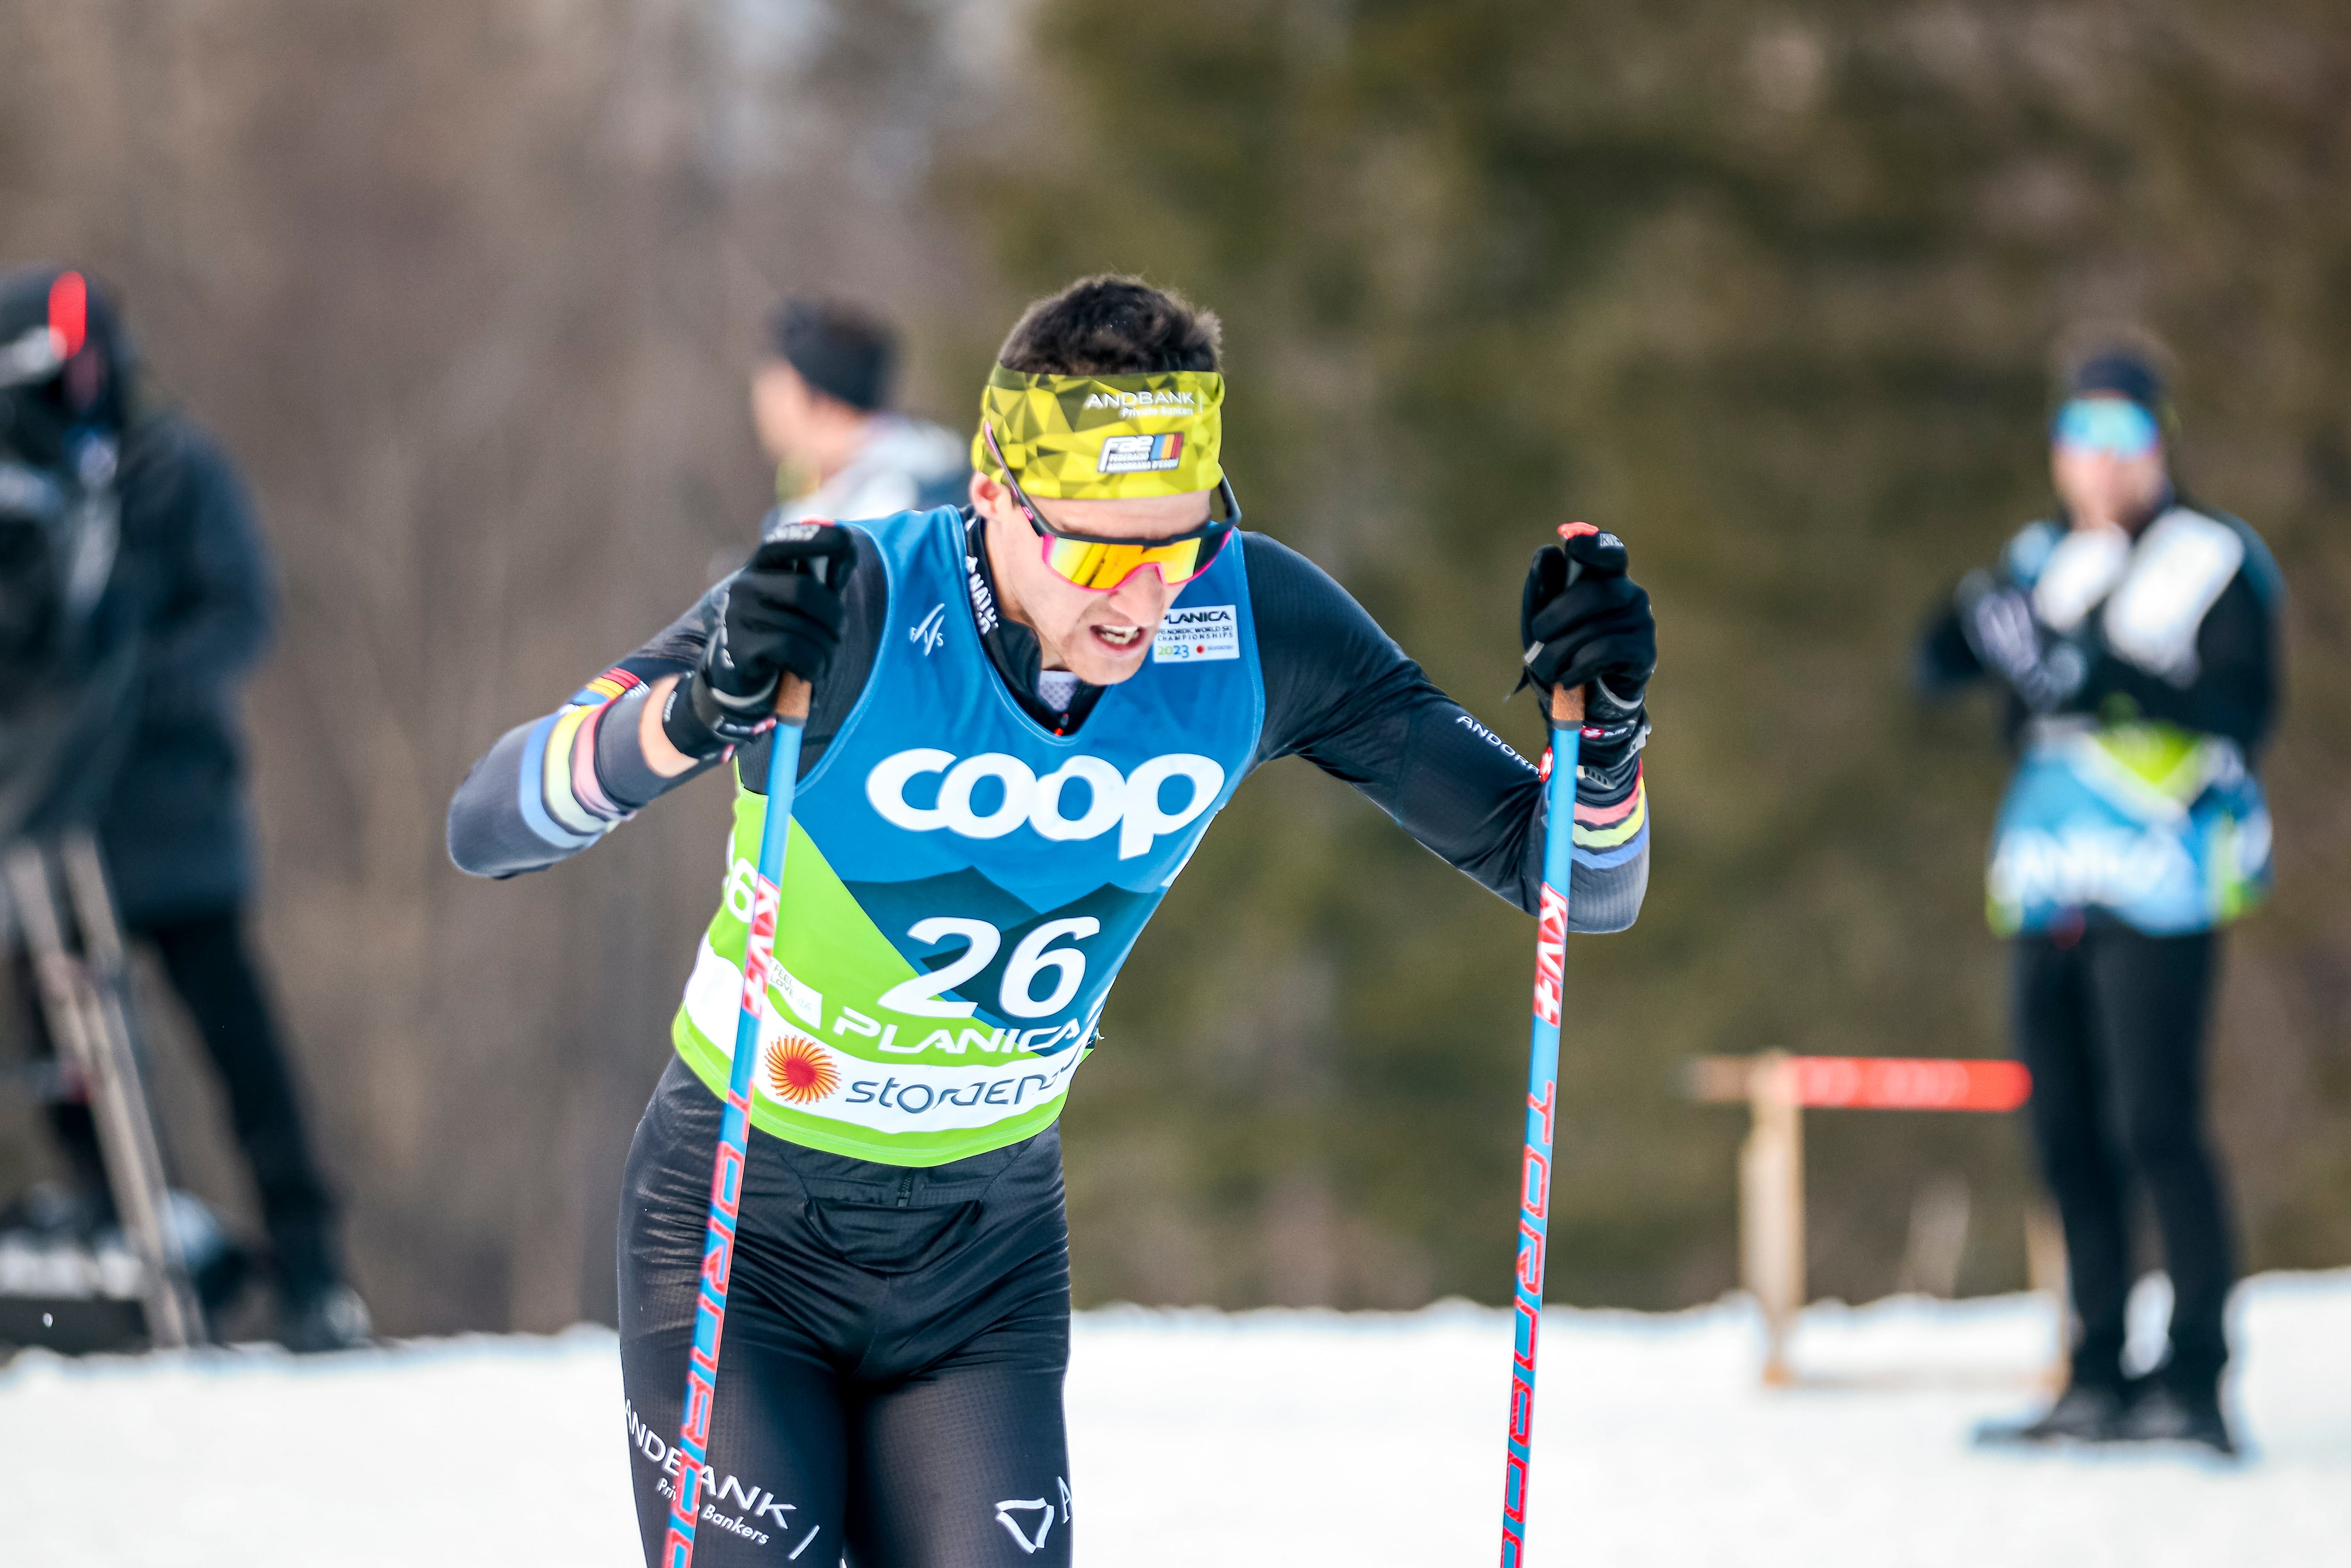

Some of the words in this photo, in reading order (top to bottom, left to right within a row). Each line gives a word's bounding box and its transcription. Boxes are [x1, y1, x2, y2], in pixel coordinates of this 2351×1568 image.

[1083, 391, 1195, 410] ANDBANK
[1164, 611, 1231, 624] LANICA
[1158, 632, 1233, 641] CHAMPIONSHIPS
[1159, 645, 1189, 658] 2023
[867, 748, 1225, 860] coop
[774, 964, 794, 988] FEEL
[878, 916, 1101, 1019] 26
[833, 1006, 1081, 1054] PLANICA
[702, 1504, 770, 1545] Bankers
